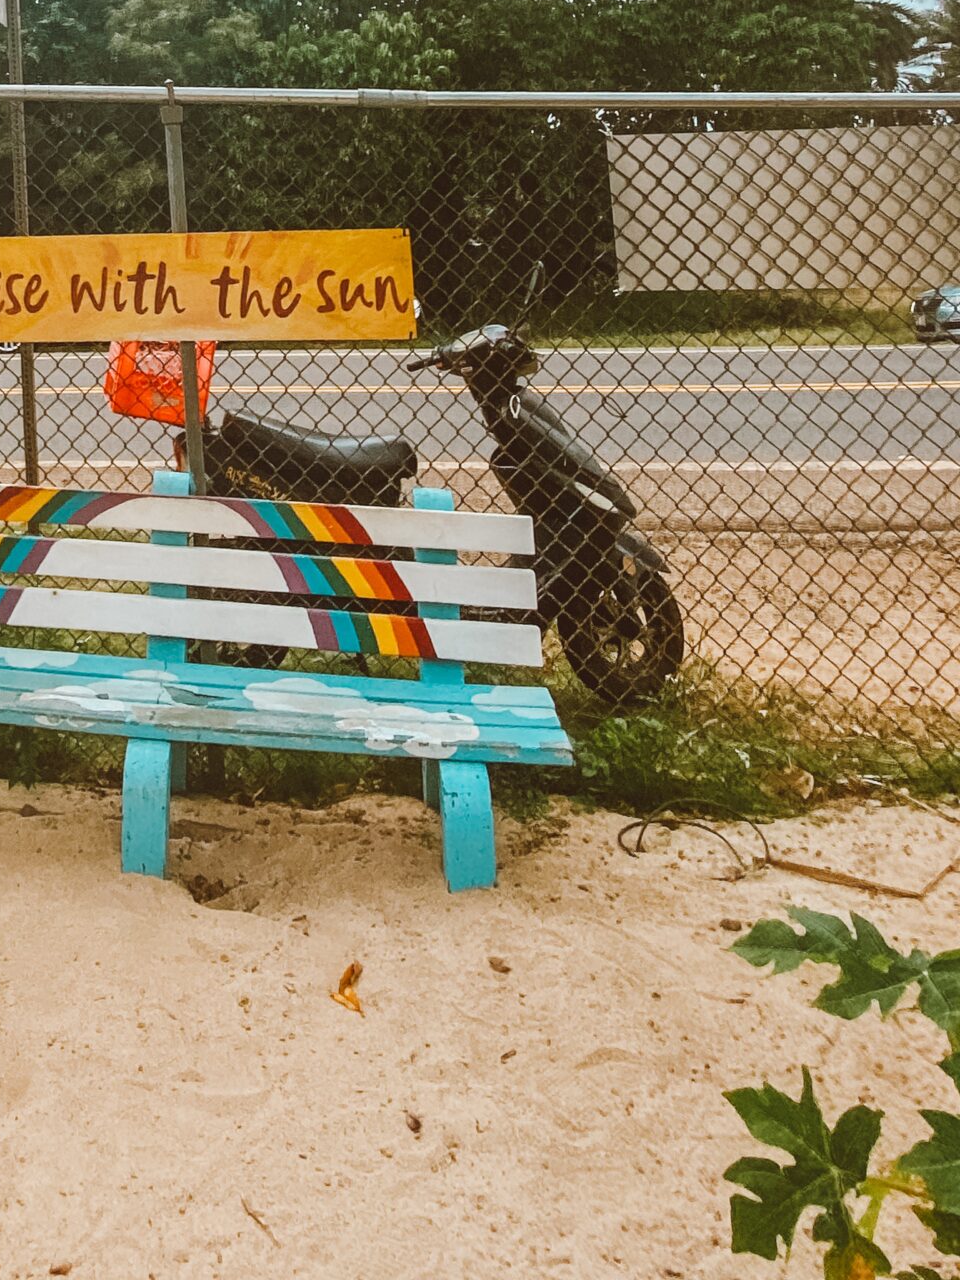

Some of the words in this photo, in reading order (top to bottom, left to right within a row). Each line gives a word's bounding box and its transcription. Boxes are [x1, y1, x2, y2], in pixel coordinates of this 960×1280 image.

[70, 261, 186, 315] with
[210, 266, 302, 319] the
[316, 269, 410, 314] sun
